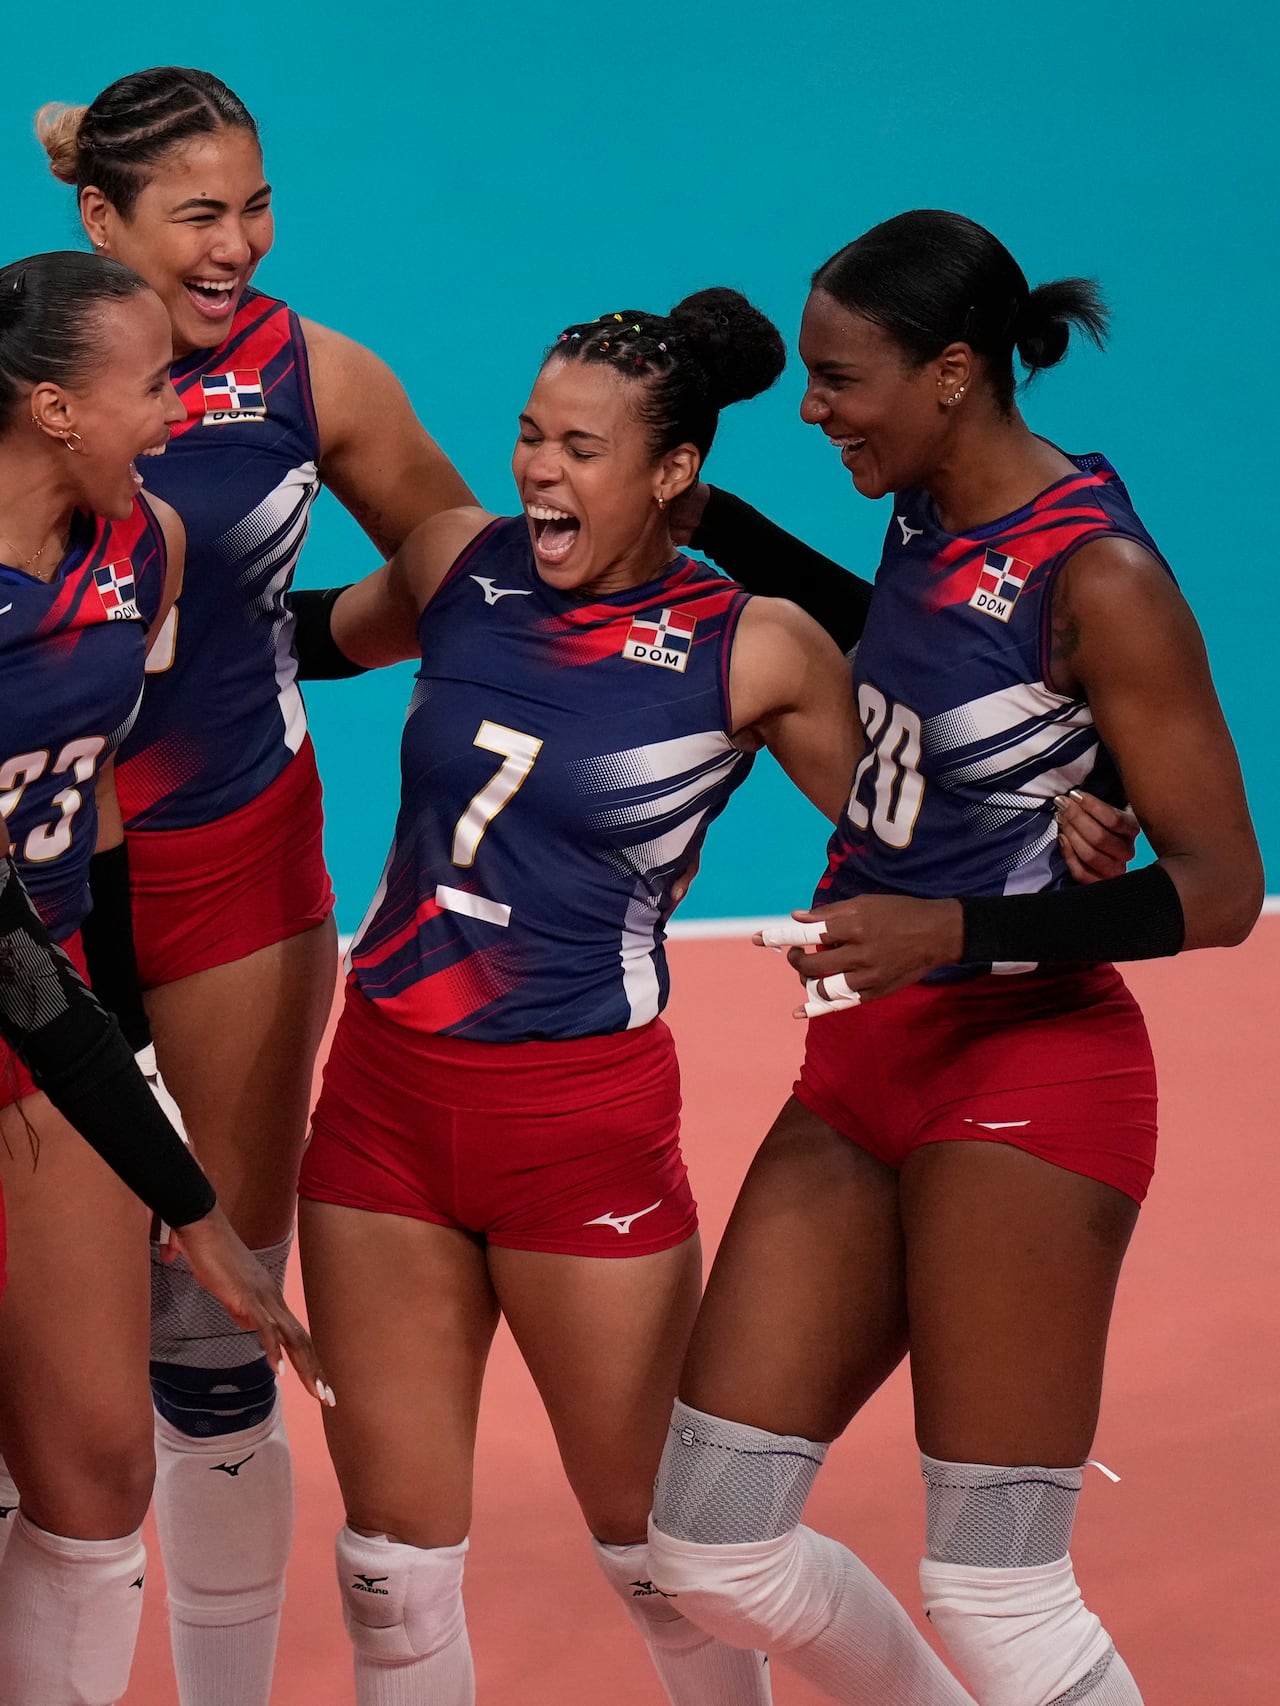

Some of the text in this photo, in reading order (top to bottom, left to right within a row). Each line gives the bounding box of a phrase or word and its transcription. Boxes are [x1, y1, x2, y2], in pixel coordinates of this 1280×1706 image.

[977, 594, 1007, 616] DOM
[634, 645, 679, 667] DOM
[451, 719, 544, 869] 7
[847, 683, 926, 849] 20
